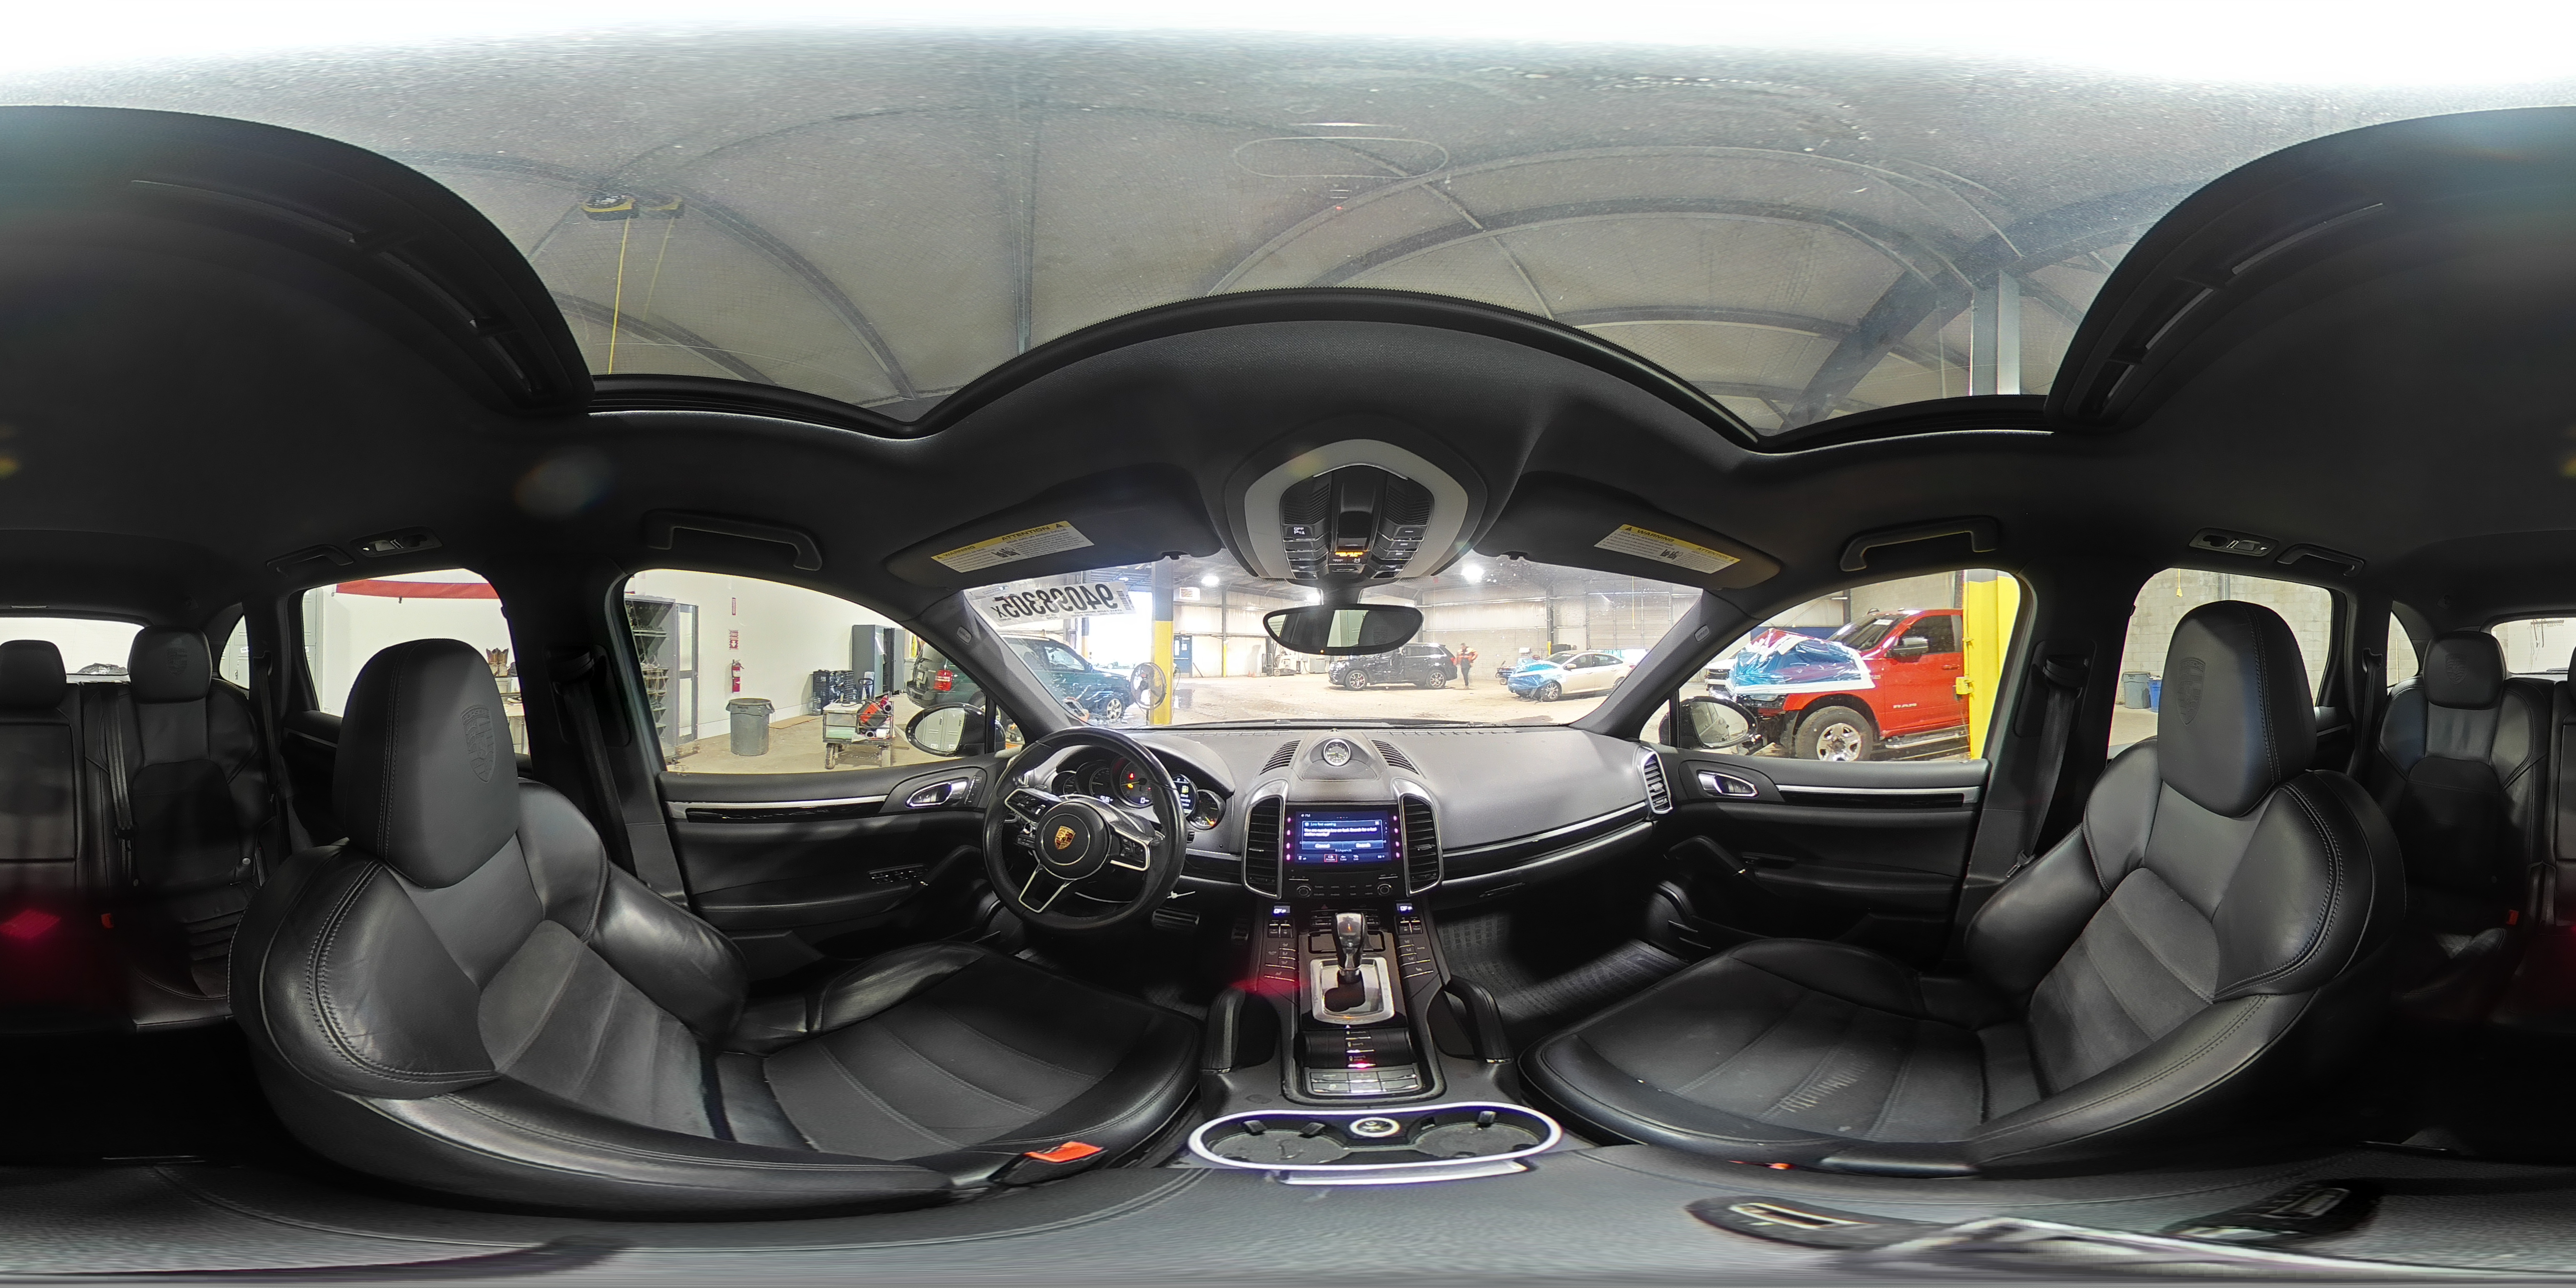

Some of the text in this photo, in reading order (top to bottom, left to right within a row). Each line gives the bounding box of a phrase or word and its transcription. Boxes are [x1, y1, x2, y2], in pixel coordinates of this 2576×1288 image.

[1001, 526, 1049, 541] ATTENTION
[1637, 529, 1675, 542] WARNING
[943, 545, 976, 557] WARNING
[1697, 547, 1729, 559] ATTENTION
